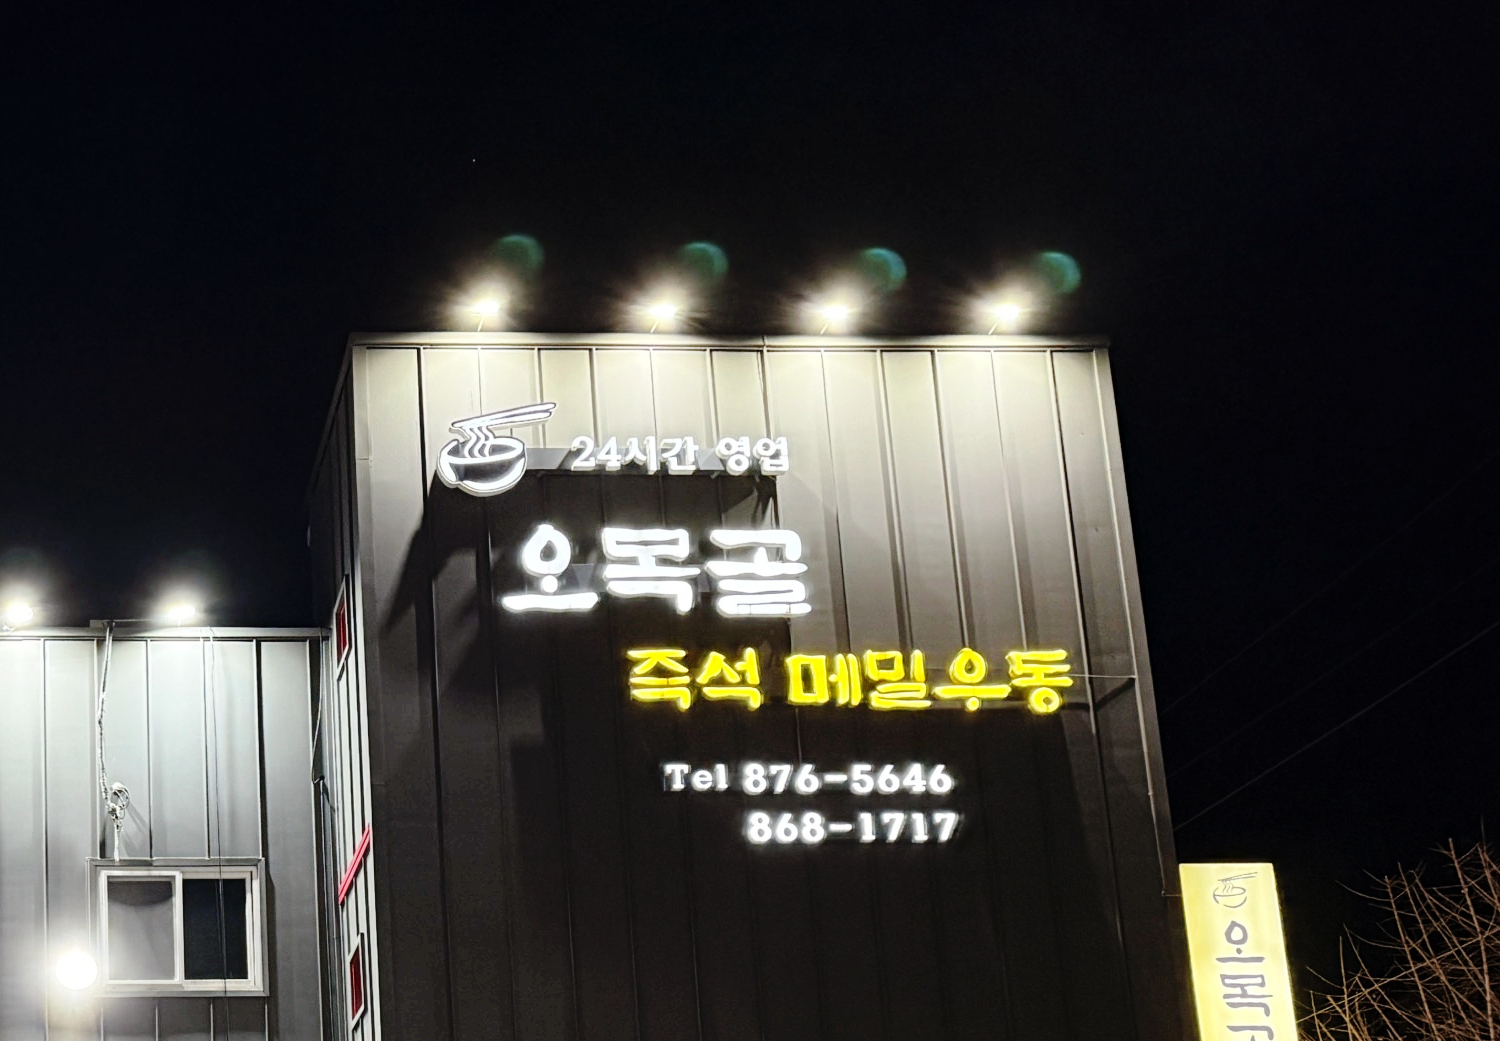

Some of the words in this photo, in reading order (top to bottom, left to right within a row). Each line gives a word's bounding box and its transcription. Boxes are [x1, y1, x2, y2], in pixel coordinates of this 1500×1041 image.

[570, 435, 699, 474] 24시간
[715, 436, 790, 475] 영업
[501, 523, 812, 618] 오목골
[627, 648, 763, 711] 즉석
[786, 648, 1073, 714] 메밀우동
[663, 764, 728, 792] Tel
[740, 763, 955, 795] 876-5646
[746, 812, 960, 844] 868-1717
